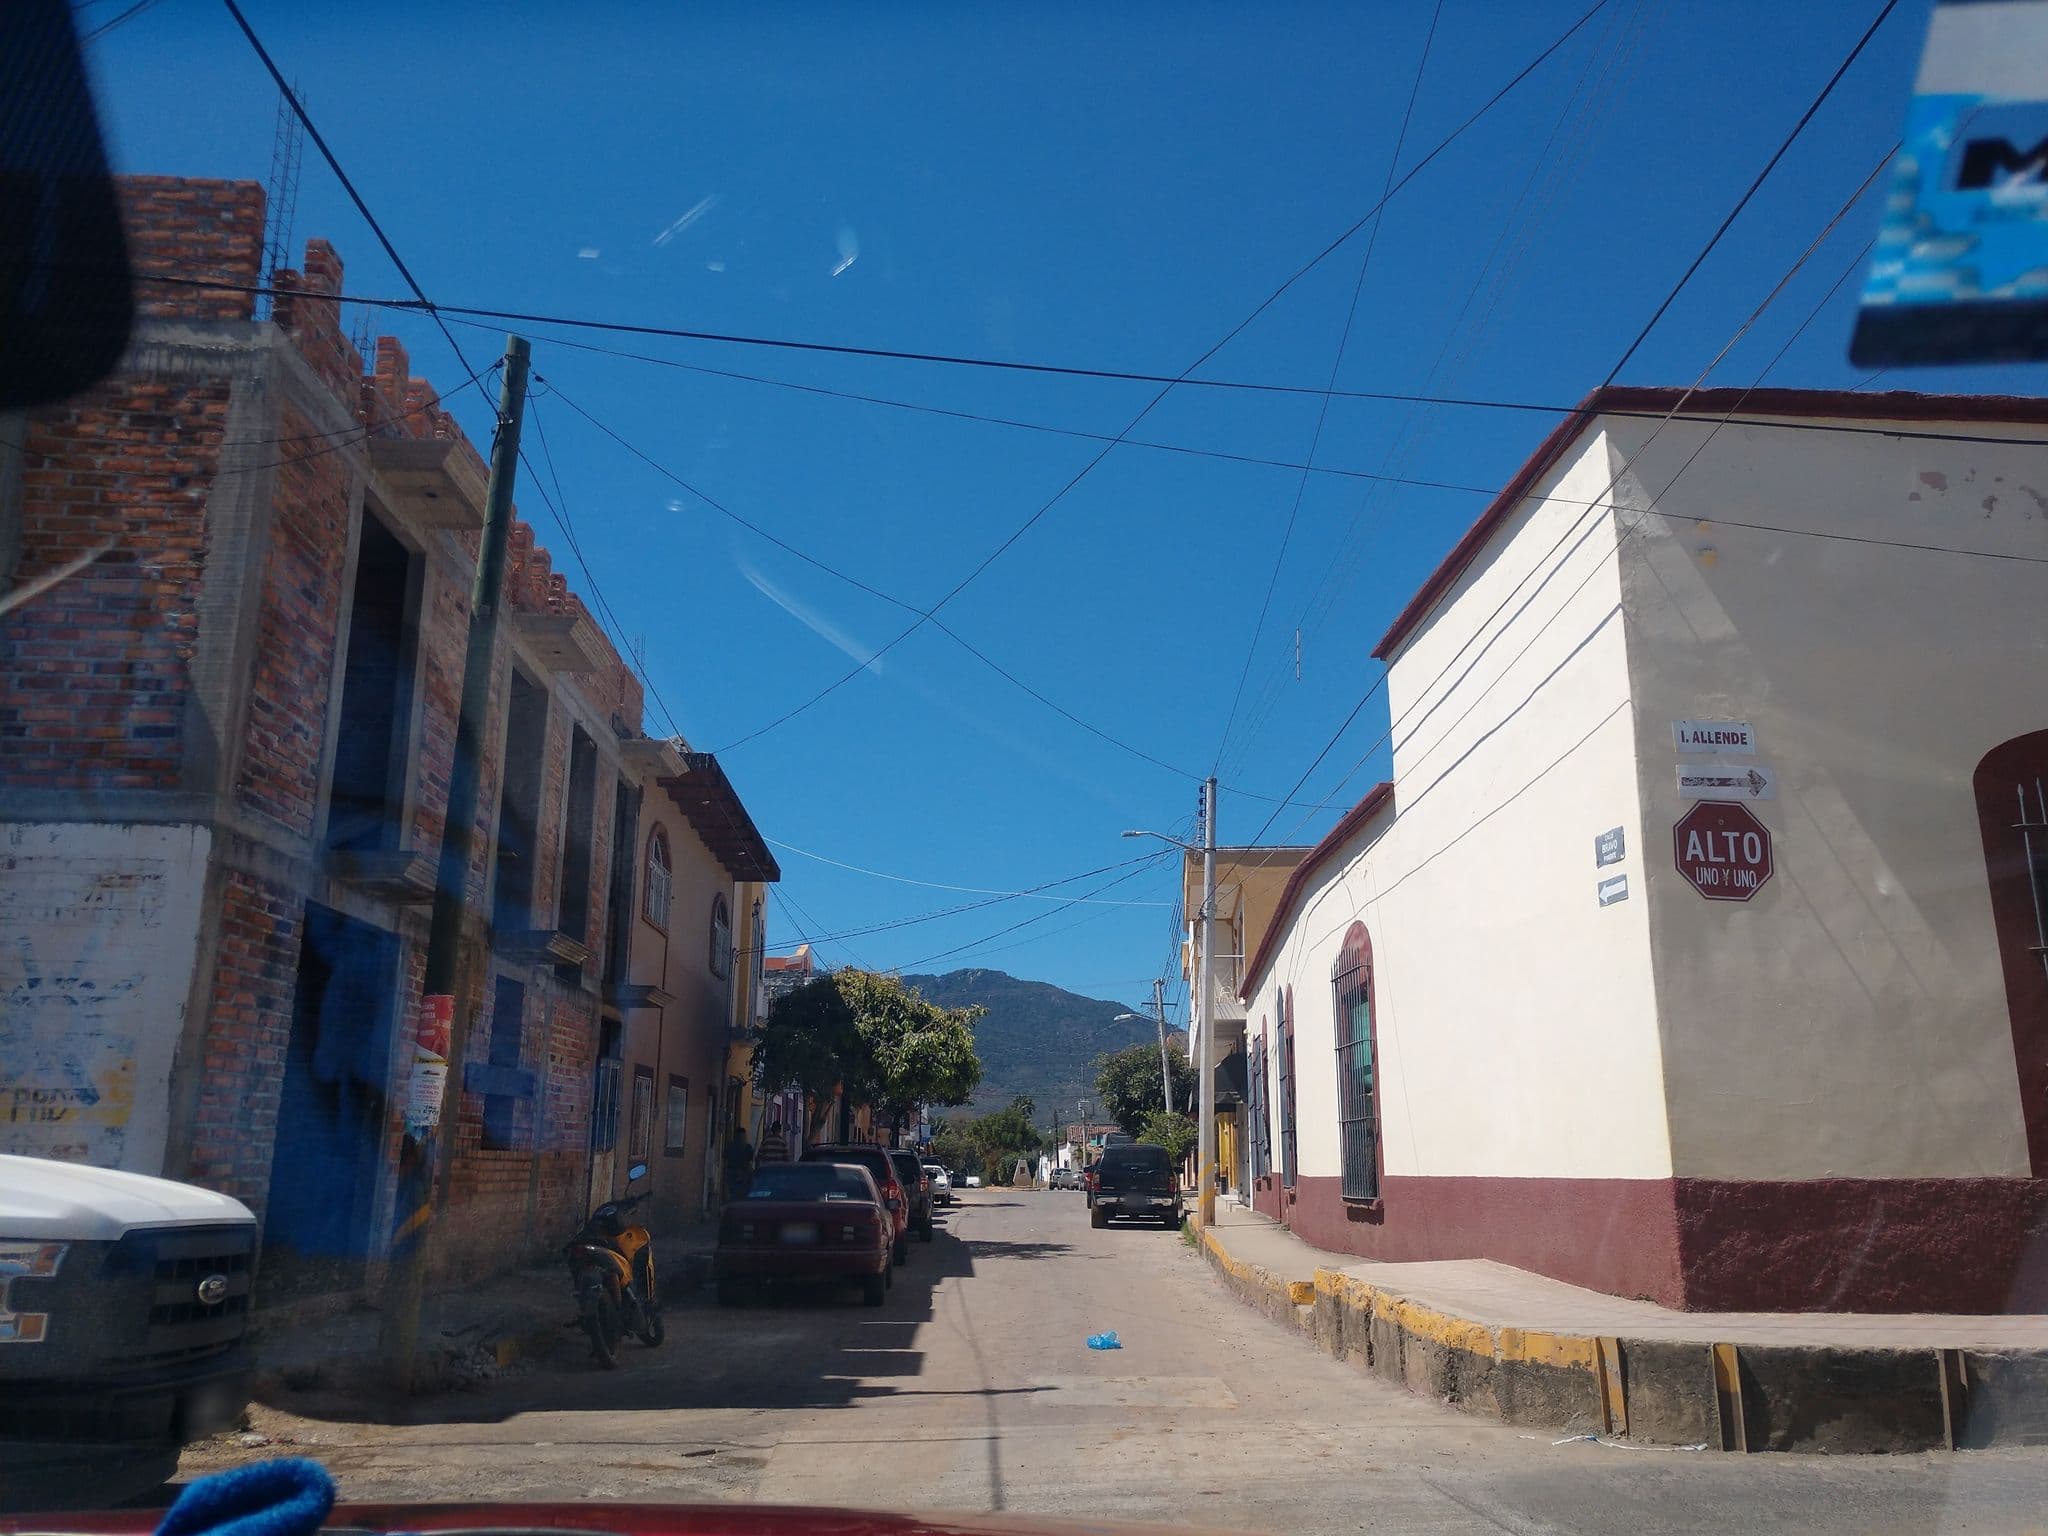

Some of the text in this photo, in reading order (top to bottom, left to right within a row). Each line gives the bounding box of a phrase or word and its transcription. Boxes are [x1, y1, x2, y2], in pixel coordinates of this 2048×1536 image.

[1680, 730, 1748, 746] I. ALLENDE
[1685, 829, 1763, 864] ALTO
[1695, 866, 1757, 888] UNO Y UNO
